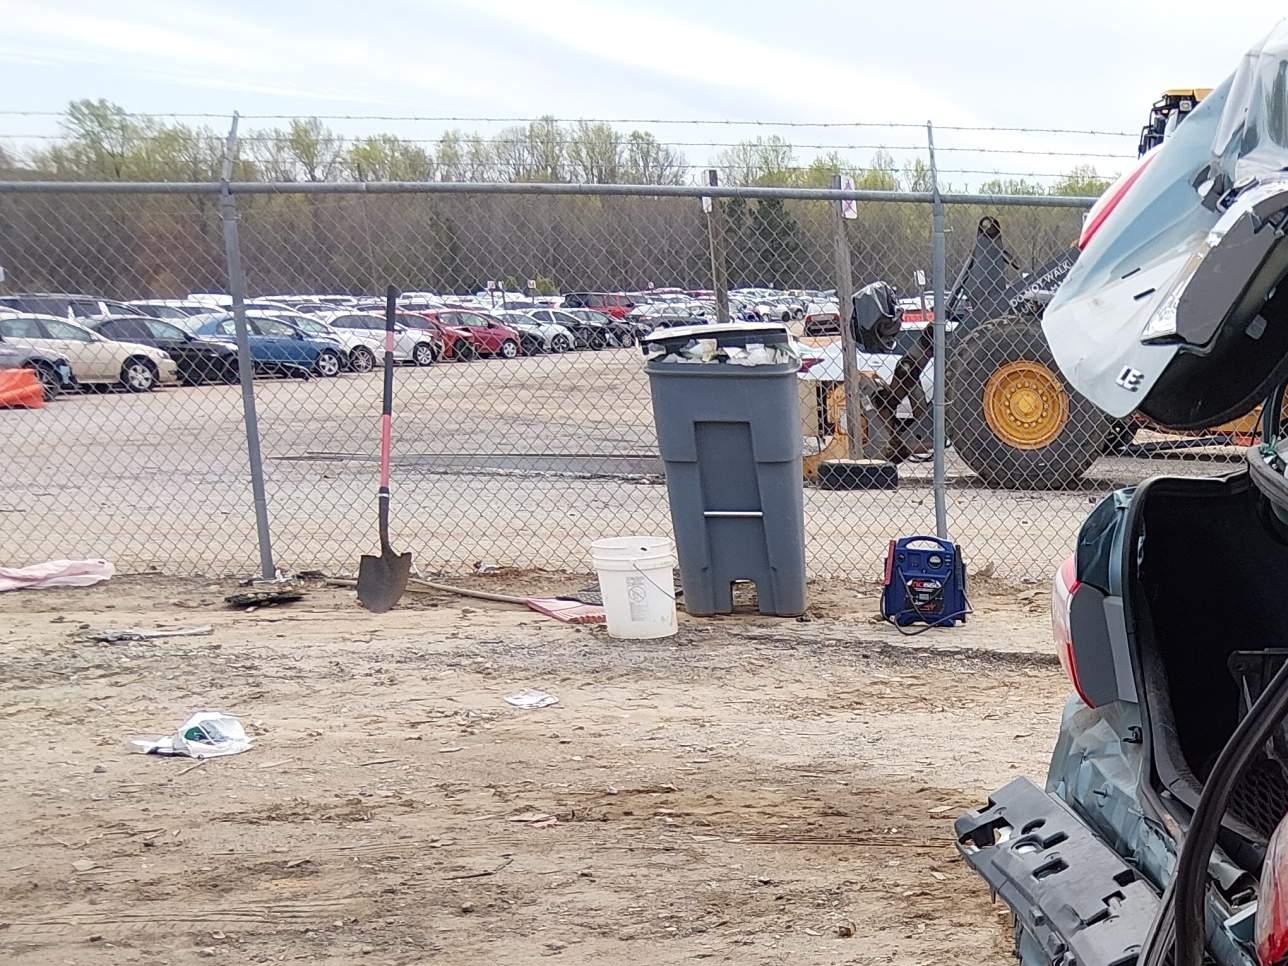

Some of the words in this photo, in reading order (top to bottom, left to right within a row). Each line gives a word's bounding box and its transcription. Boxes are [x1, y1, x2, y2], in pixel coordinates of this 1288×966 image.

[1009, 294, 1024, 308] DO
[1024, 280, 1045, 300] NOT
[1045, 260, 1071, 283] WALK
